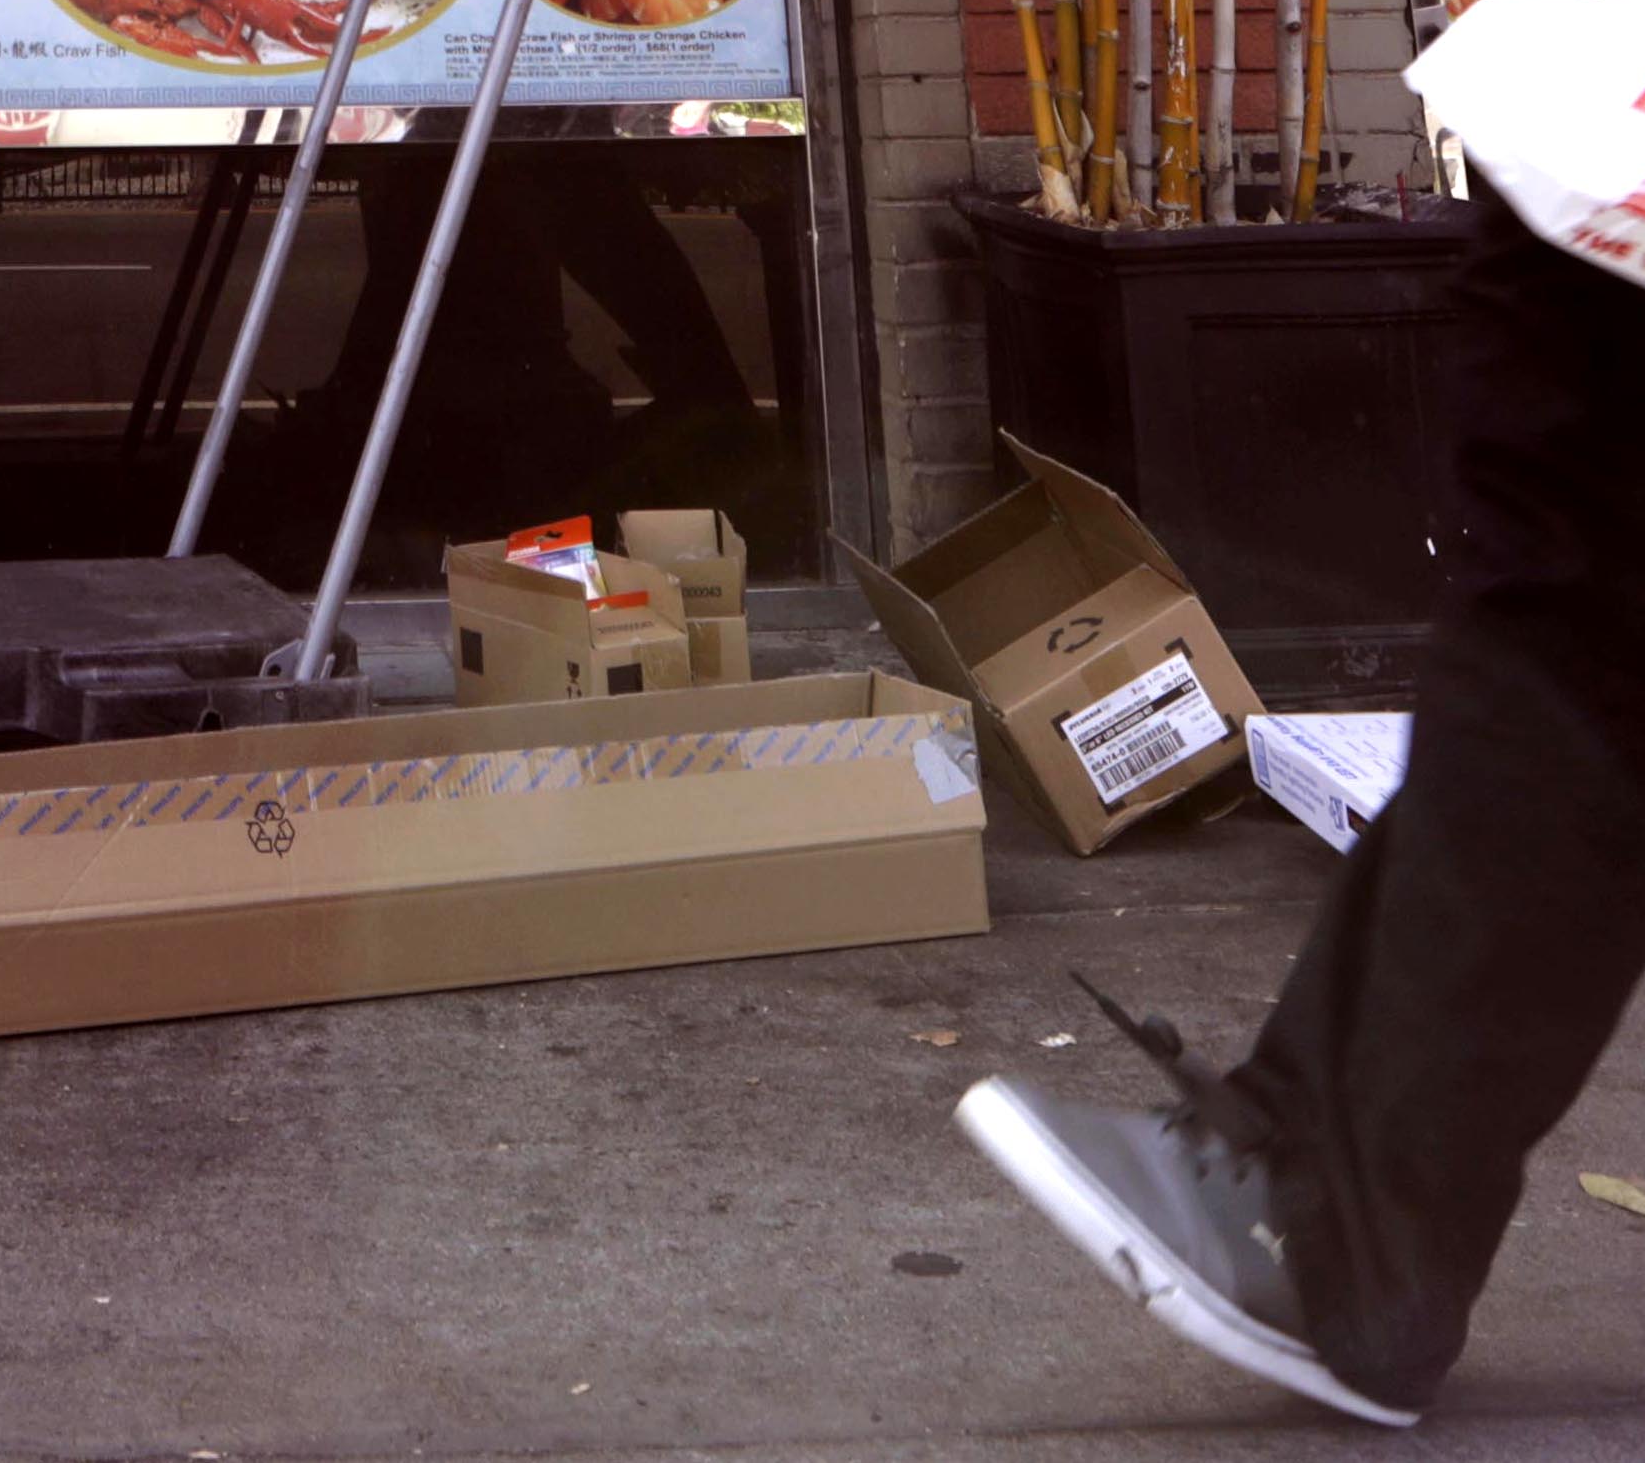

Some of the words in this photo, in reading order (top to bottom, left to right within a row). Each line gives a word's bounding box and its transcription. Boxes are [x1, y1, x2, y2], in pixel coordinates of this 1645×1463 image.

[445, 33, 466, 43] Can
[550, 32, 576, 42] Fish
[579, 33, 591, 42] or
[593, 32, 635, 44] Shrimp
[638, 32, 651, 42] or
[654, 32, 696, 44] Orange
[698, 31, 746, 41] Chicken
[53, 44, 90, 58] Craw
[96, 44, 126, 58] Fish
[444, 44, 469, 54] with
[680, 43, 715, 55] order)
[1572, 227, 1629, 258] THE
